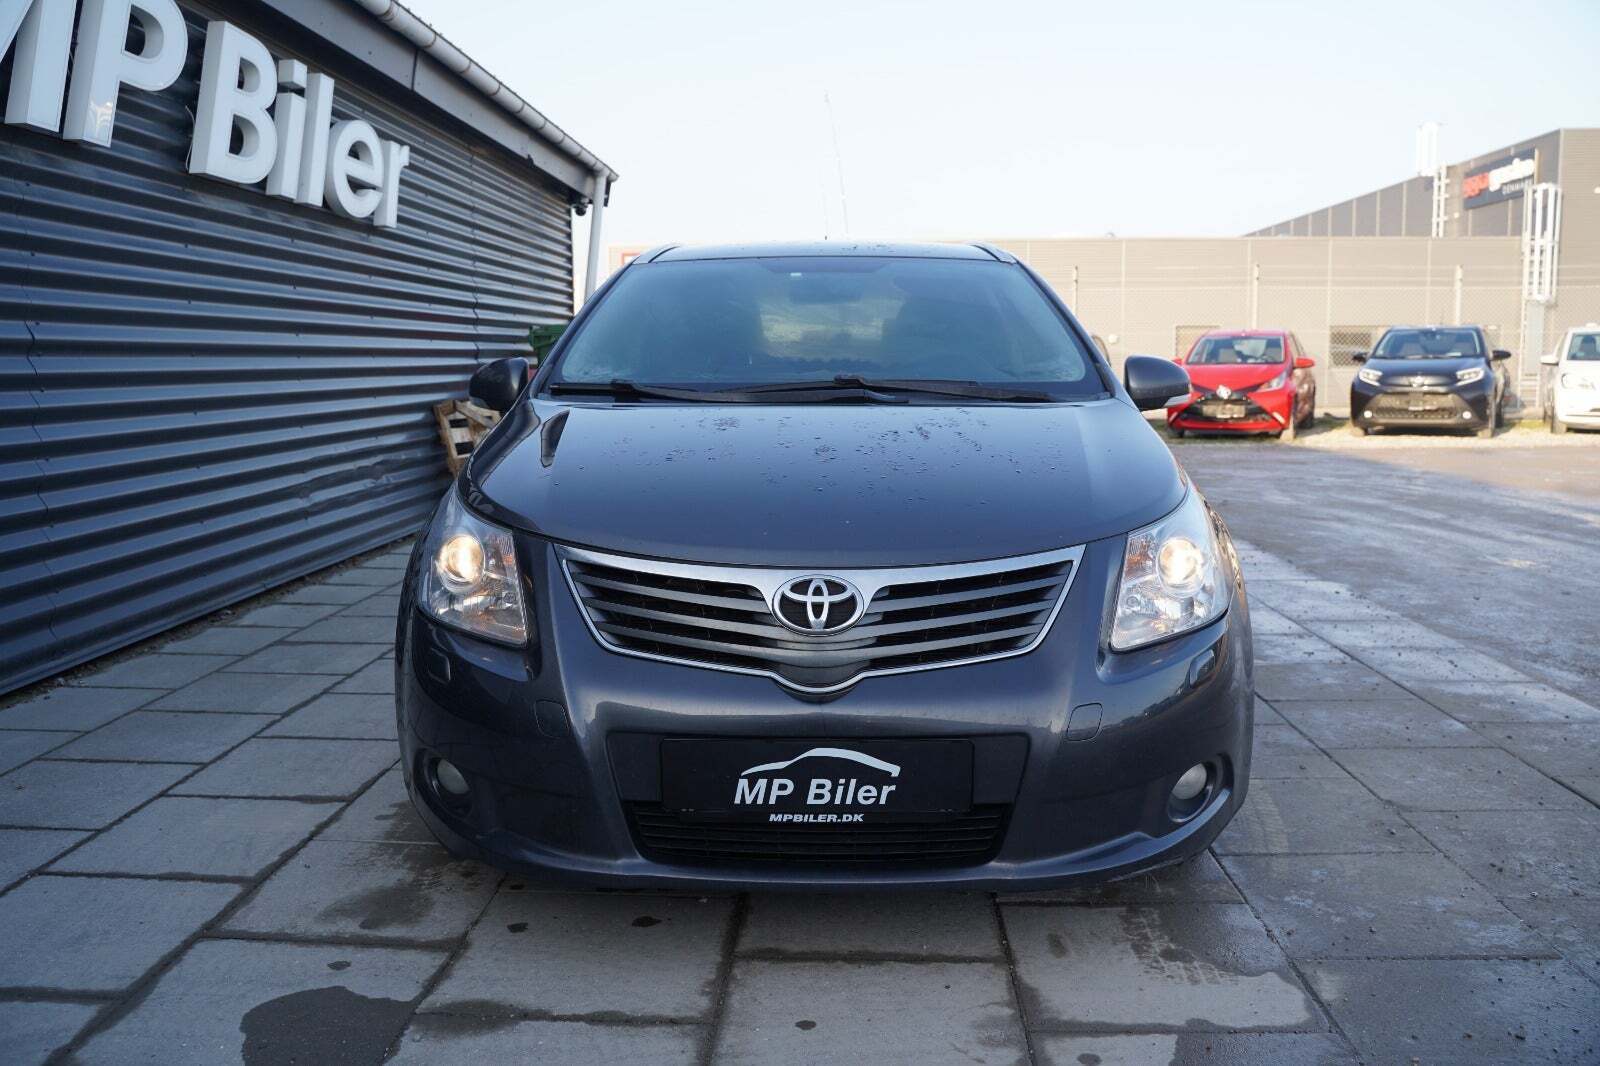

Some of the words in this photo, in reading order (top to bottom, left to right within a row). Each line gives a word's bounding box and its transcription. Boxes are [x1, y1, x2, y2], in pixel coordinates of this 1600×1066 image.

[189, 20, 411, 228] Biler
[734, 778, 795, 805] MP
[806, 778, 897, 806] Biler
[768, 813, 865, 823] MPBILER.DK
